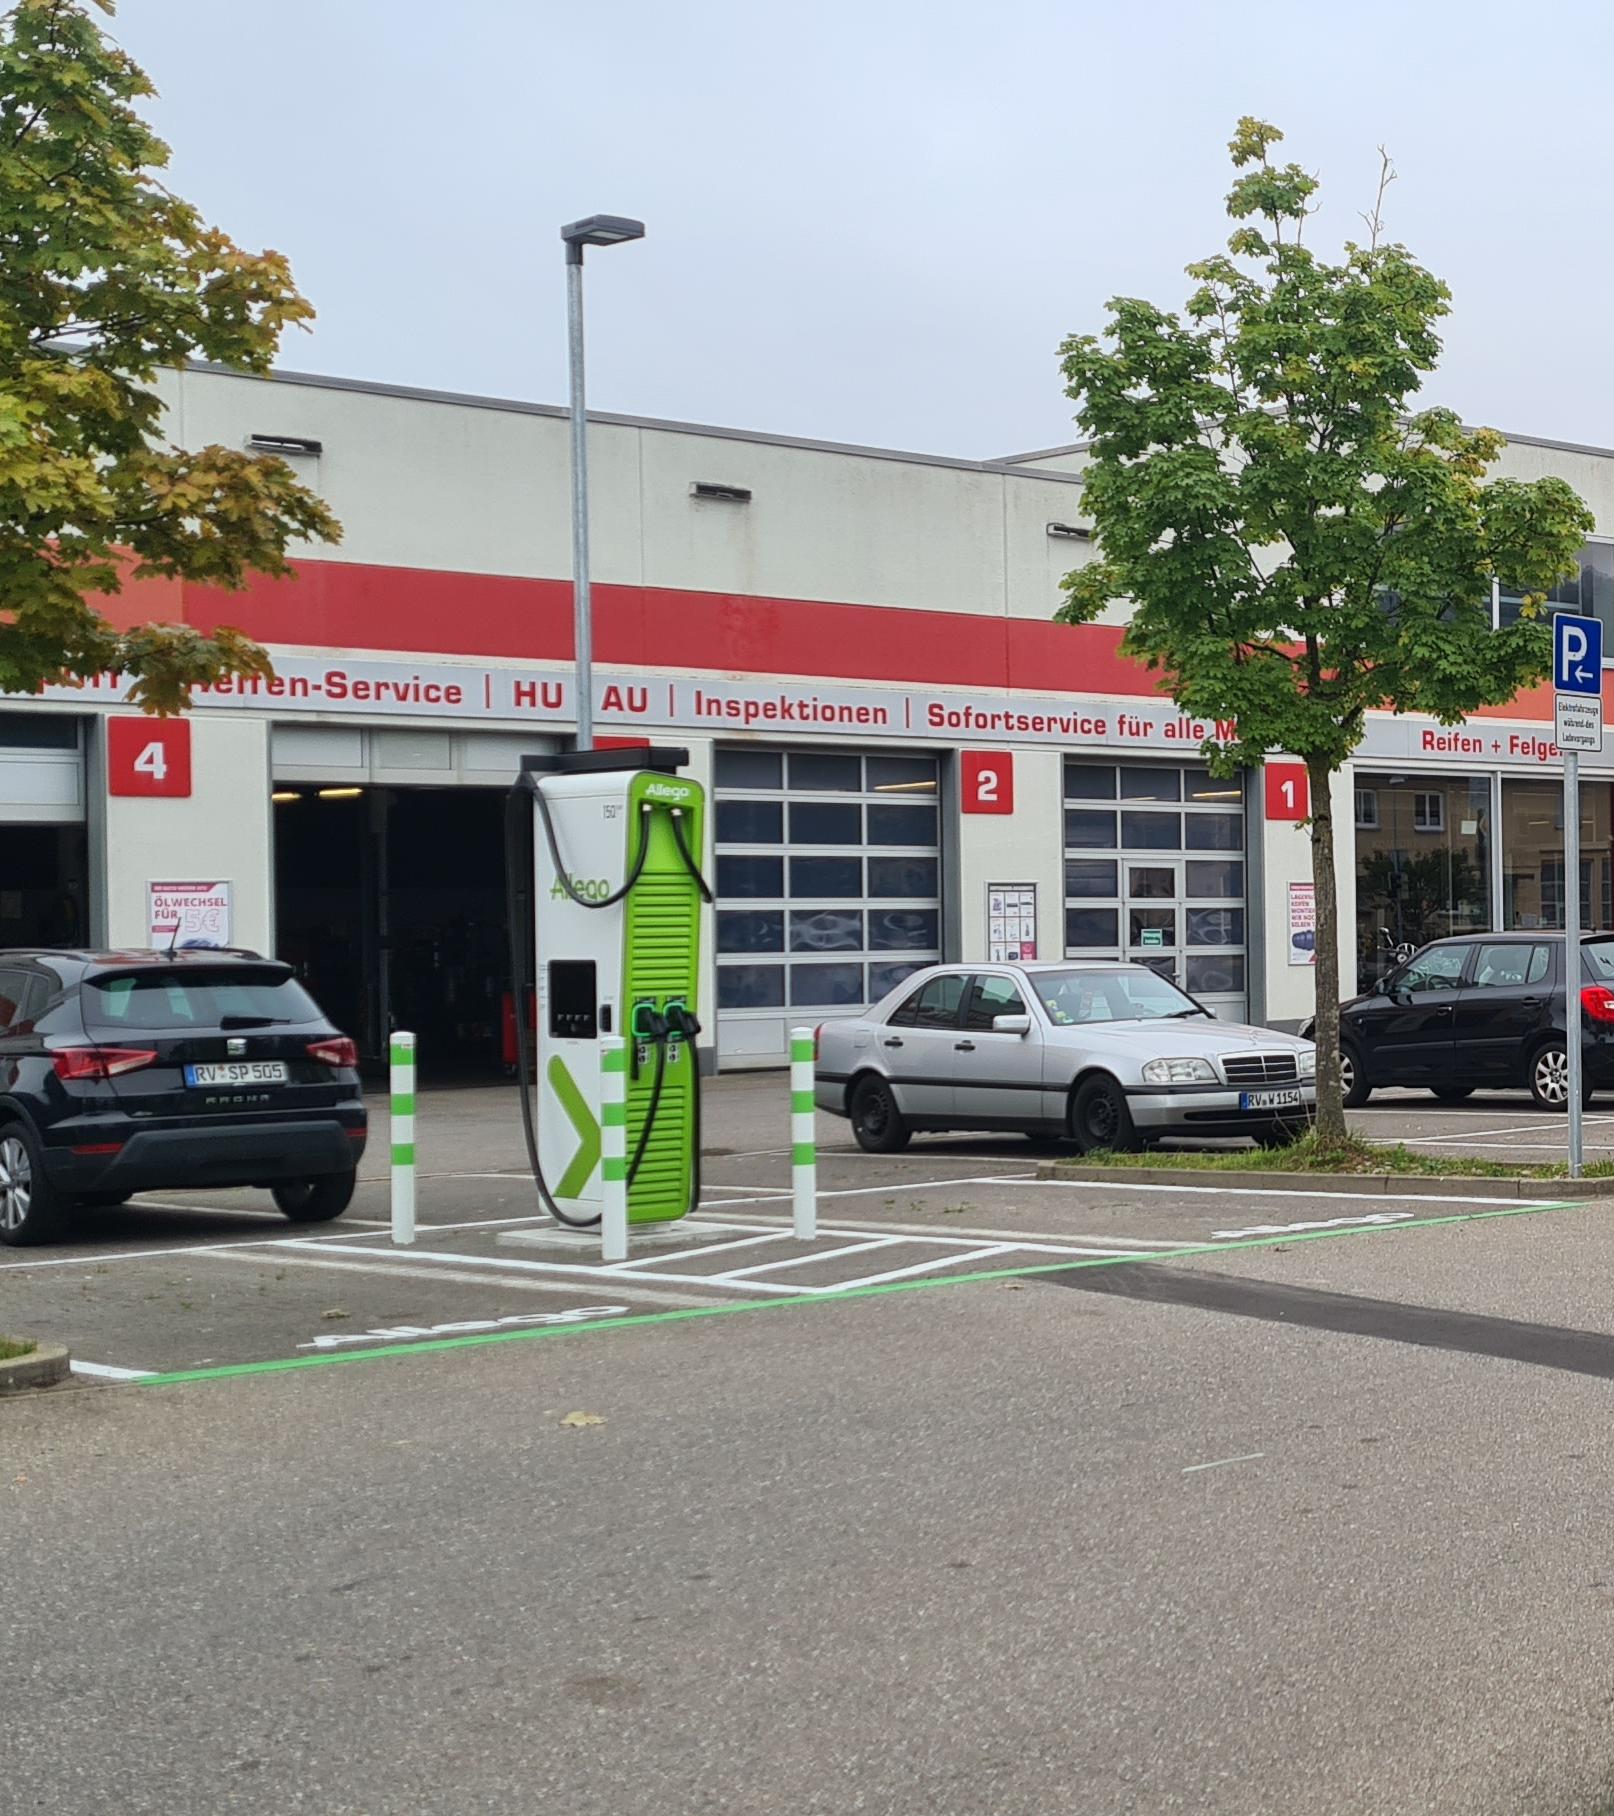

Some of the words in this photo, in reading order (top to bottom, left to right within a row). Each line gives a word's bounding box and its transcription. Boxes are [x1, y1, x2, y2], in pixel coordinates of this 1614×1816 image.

[1562, 624, 1588, 682] P
[513, 679, 563, 709] HU
[601, 685, 648, 713] AU
[694, 689, 889, 725] Inspektionen
[927, 702, 1107, 736] Sofortservice
[1117, 713, 1154, 738] für
[1163, 716, 1205, 741] alle
[133, 741, 168, 780] 4
[1421, 729, 1483, 753] Reifen
[1509, 734, 1563, 762] Felge
[645, 783, 690, 800] Allego
[976, 769, 998, 801] 2
[1280, 779, 1295, 809] 1
[154, 895, 228, 908] ÖLWECHSEL
[154, 907, 178, 920] FÜR
[195, 1066, 216, 1082] RV
[228, 1065, 249, 1080] SP
[251, 1063, 282, 1080] 505
[1248, 1094, 1262, 1108] RV
[1276, 1091, 1299, 1106] 1154
